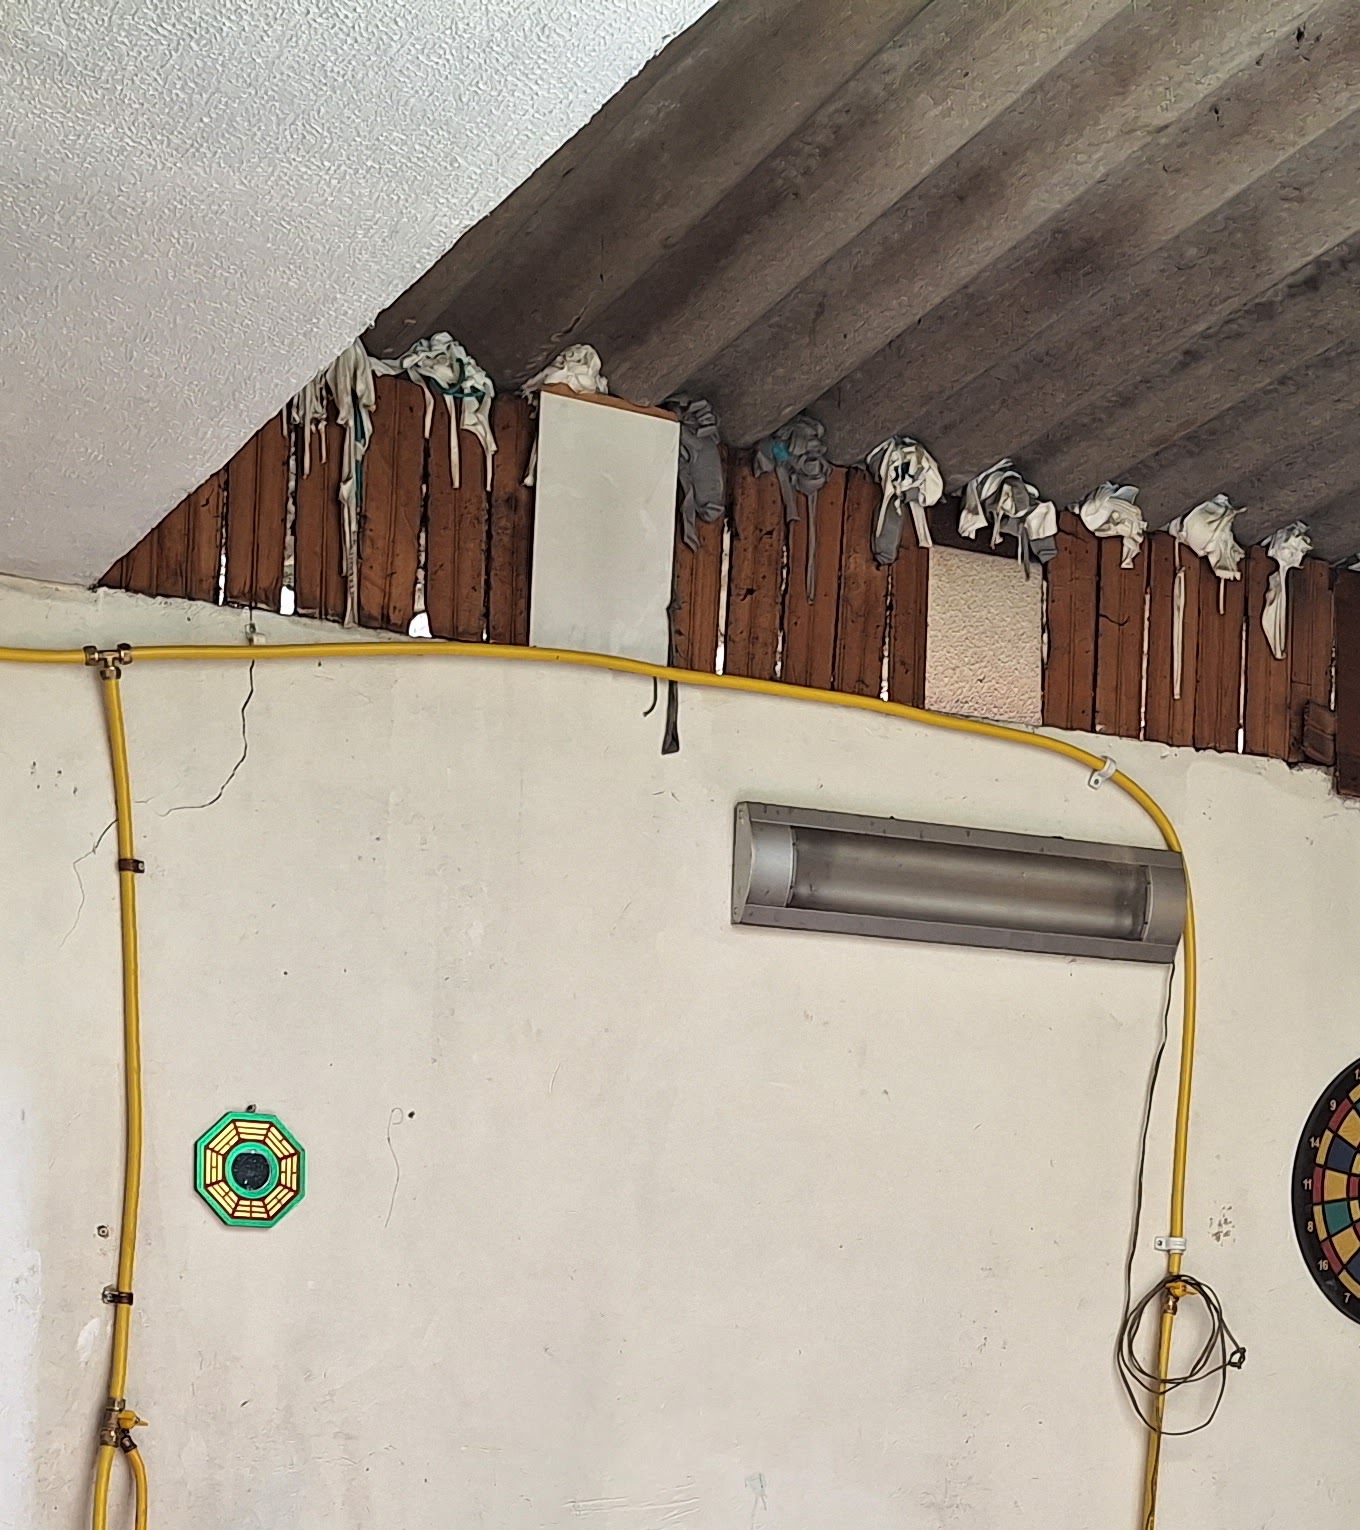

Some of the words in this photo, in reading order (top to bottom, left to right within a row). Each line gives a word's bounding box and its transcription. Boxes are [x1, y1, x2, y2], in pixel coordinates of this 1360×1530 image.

[1330, 1100, 1336, 1111] 9
[1309, 1138, 1319, 1148] 14
[1303, 1179, 1312, 1189] 11
[1308, 1221, 1313, 1232] 8
[1318, 1260, 1328, 1271] 16
[1345, 1293, 1350, 1303] 7
